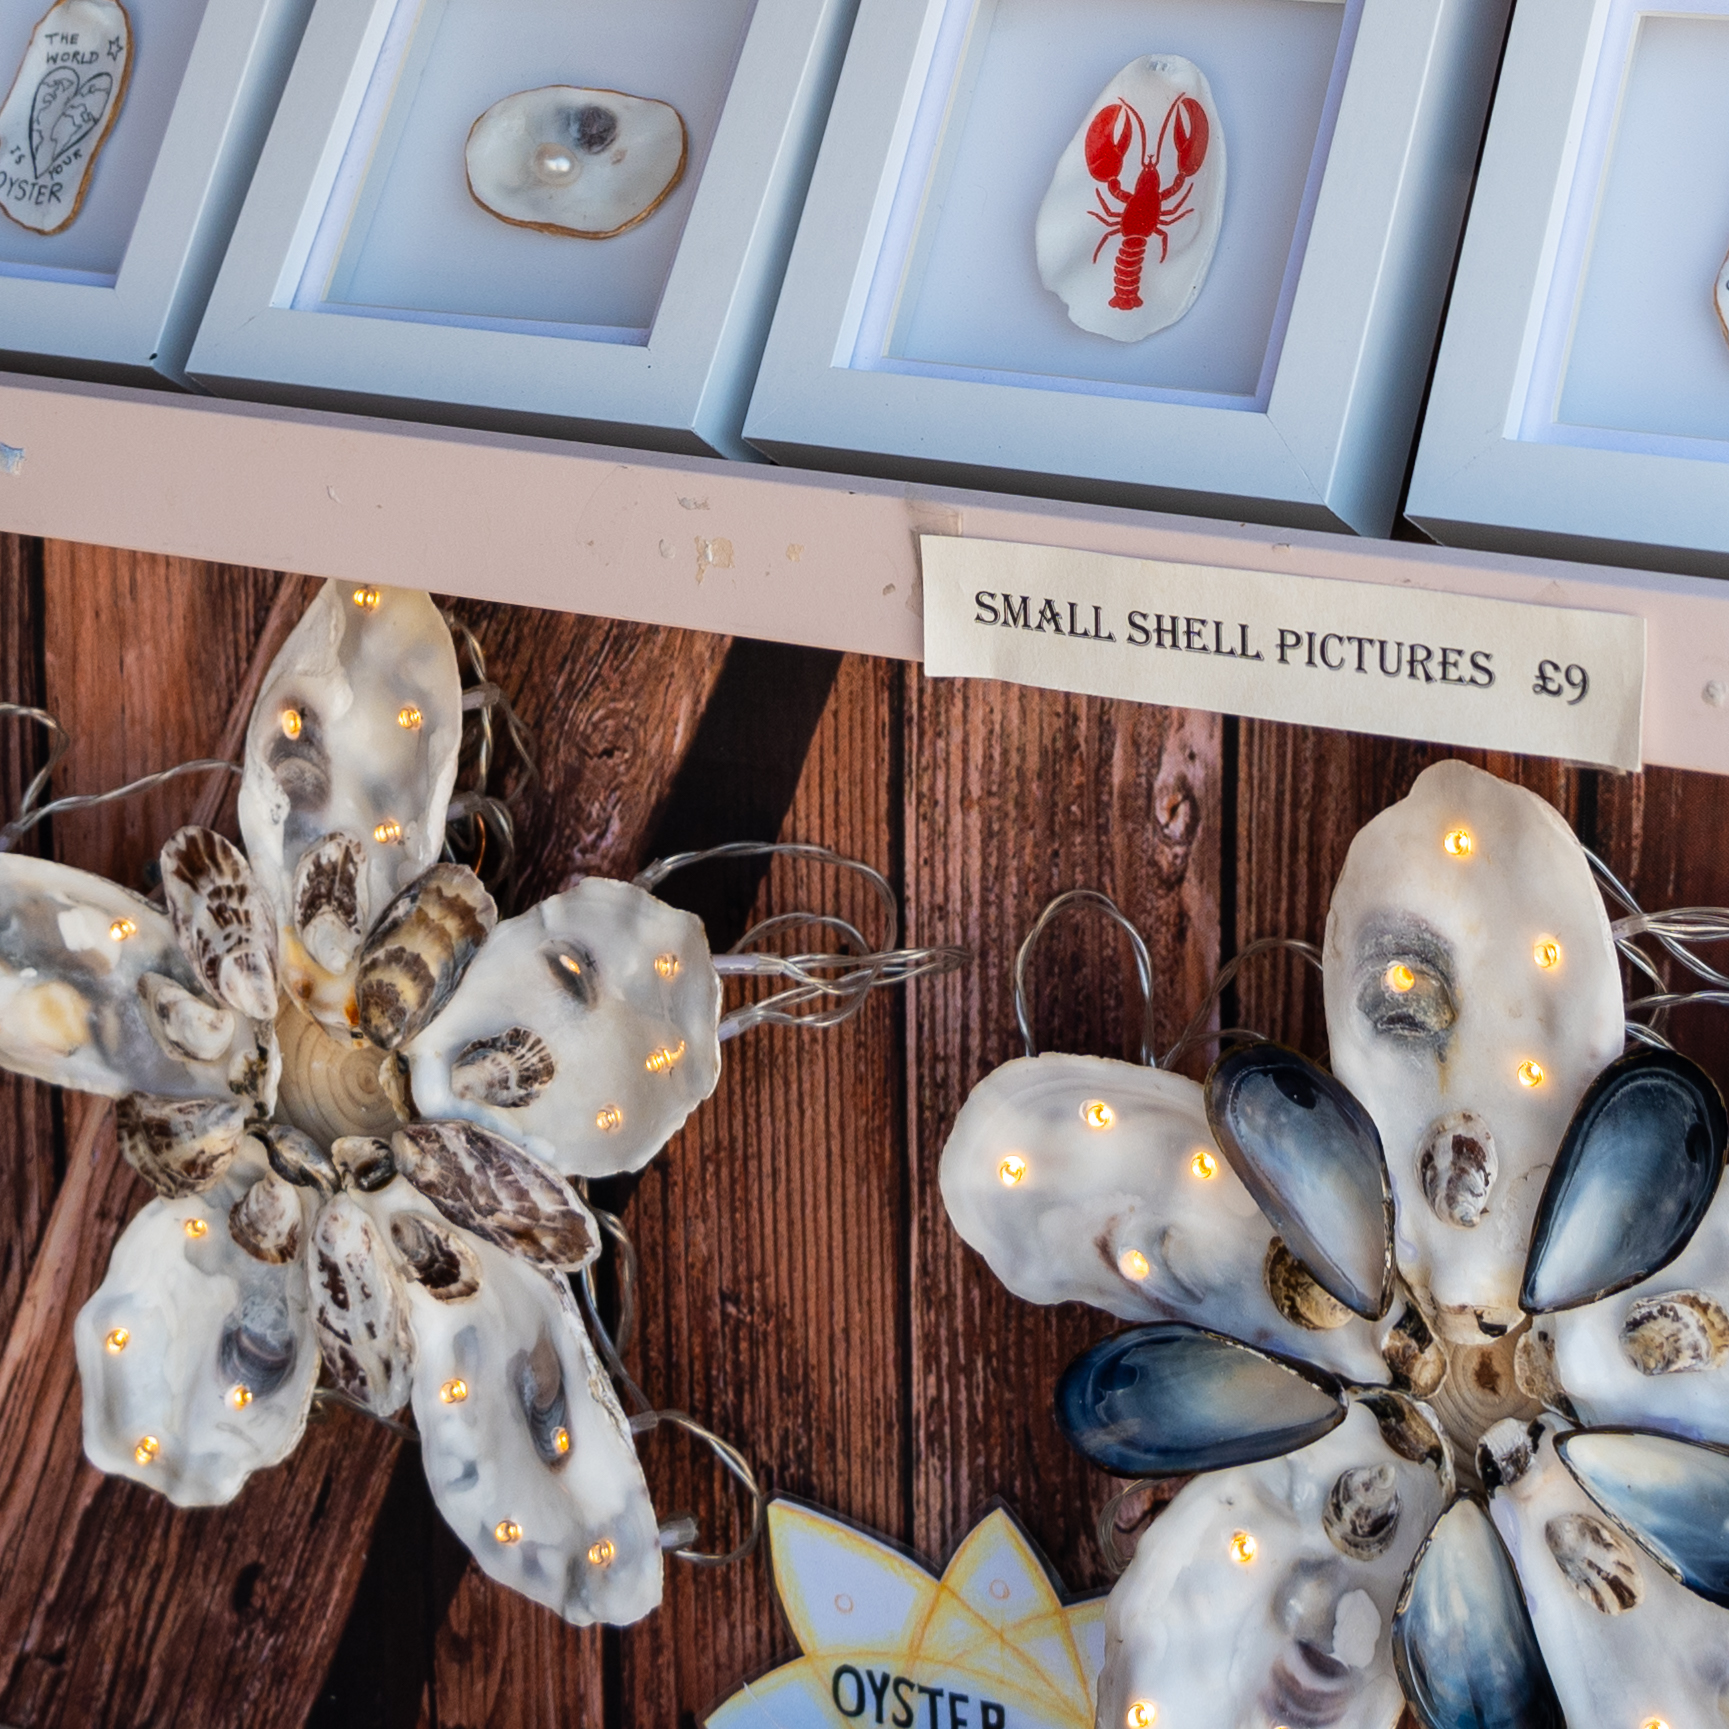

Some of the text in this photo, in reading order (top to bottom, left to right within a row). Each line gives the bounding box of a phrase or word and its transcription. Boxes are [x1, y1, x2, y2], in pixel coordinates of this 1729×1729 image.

[45, 32, 80, 46] THE
[46, 51, 99, 65] WORLD
[973, 590, 1591, 705] SMALL SHELL PICTURES £9
